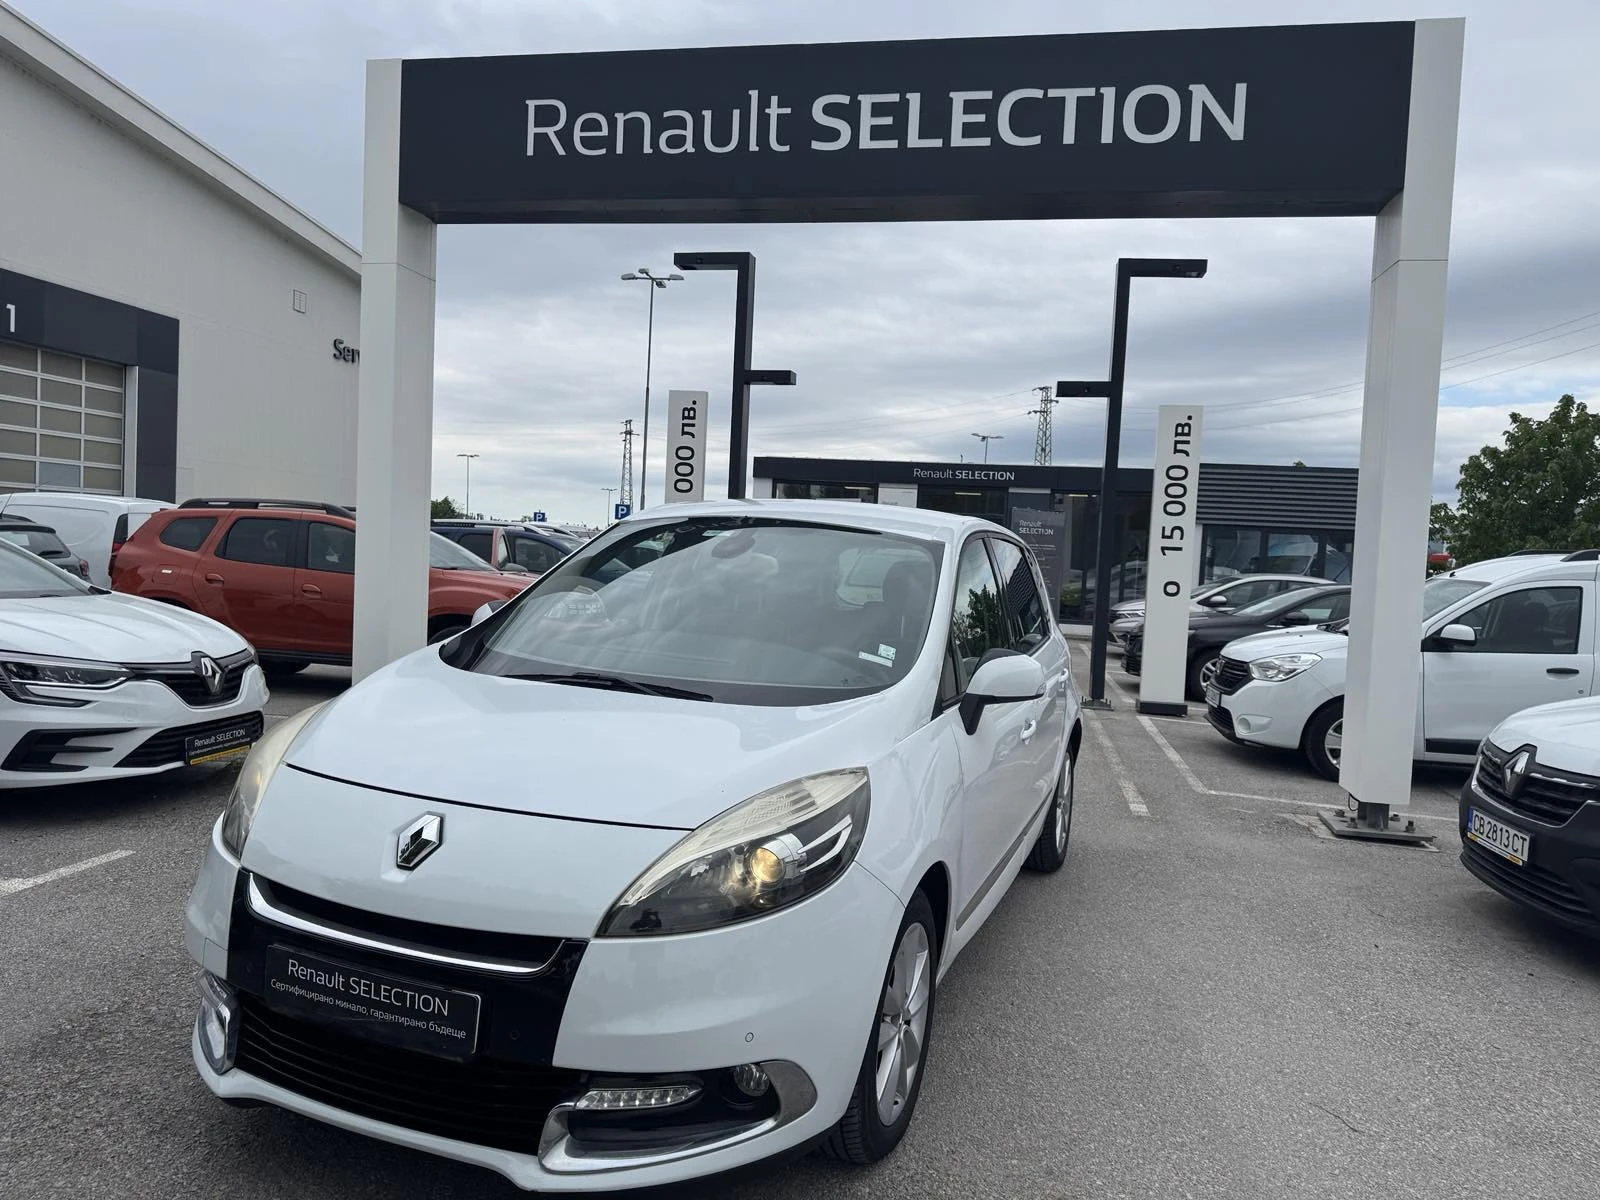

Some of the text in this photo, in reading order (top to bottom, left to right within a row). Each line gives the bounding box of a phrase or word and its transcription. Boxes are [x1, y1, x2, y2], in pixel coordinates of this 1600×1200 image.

[525, 82, 1248, 156] Renault SELECTION
[6, 303, 16, 333] 1
[673, 399, 697, 494] 000 лв.
[1173, 414, 1193, 457] лв.
[913, 468, 1015, 481] Renault SELECTION
[1162, 464, 1189, 517] 000
[618, 506, 627, 518] P
[1020, 519, 1042, 528] Renault
[1019, 527, 1054, 536] SELECTION
[1160, 525, 1185, 557] 15
[194, 736, 215, 747] Renault
[216, 728, 246, 743] SELECTION
[288, 958, 449, 1017] Renault SELECTION
[270, 978, 467, 1040] Сертифицирано минало, гарантирано бъдеще
